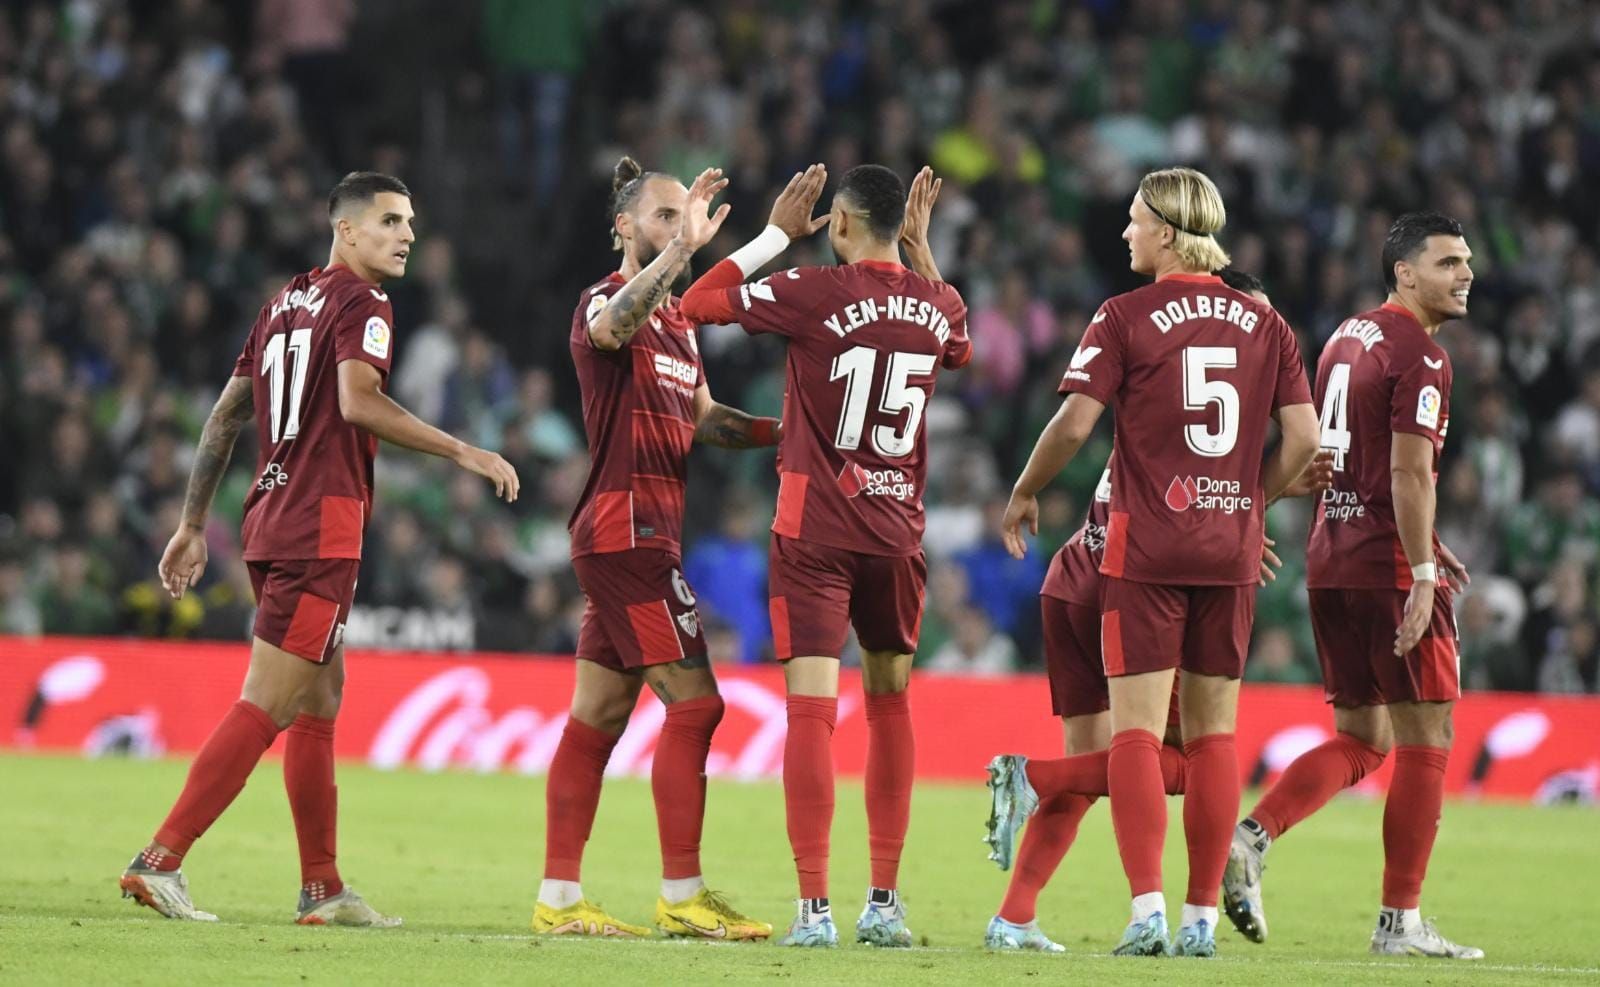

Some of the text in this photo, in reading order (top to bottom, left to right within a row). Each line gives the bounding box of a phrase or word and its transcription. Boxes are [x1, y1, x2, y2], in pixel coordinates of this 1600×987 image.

[1150, 295, 1259, 334] DOLBERG
[261, 328, 313, 444] 17
[829, 345, 938, 457] 15
[1182, 346, 1240, 457] 5
[1319, 363, 1351, 472] 4
[866, 481, 915, 501] sangre
[1195, 494, 1252, 514] sangre
[1196, 476, 1240, 493] Dona
[672, 567, 696, 607] 6
